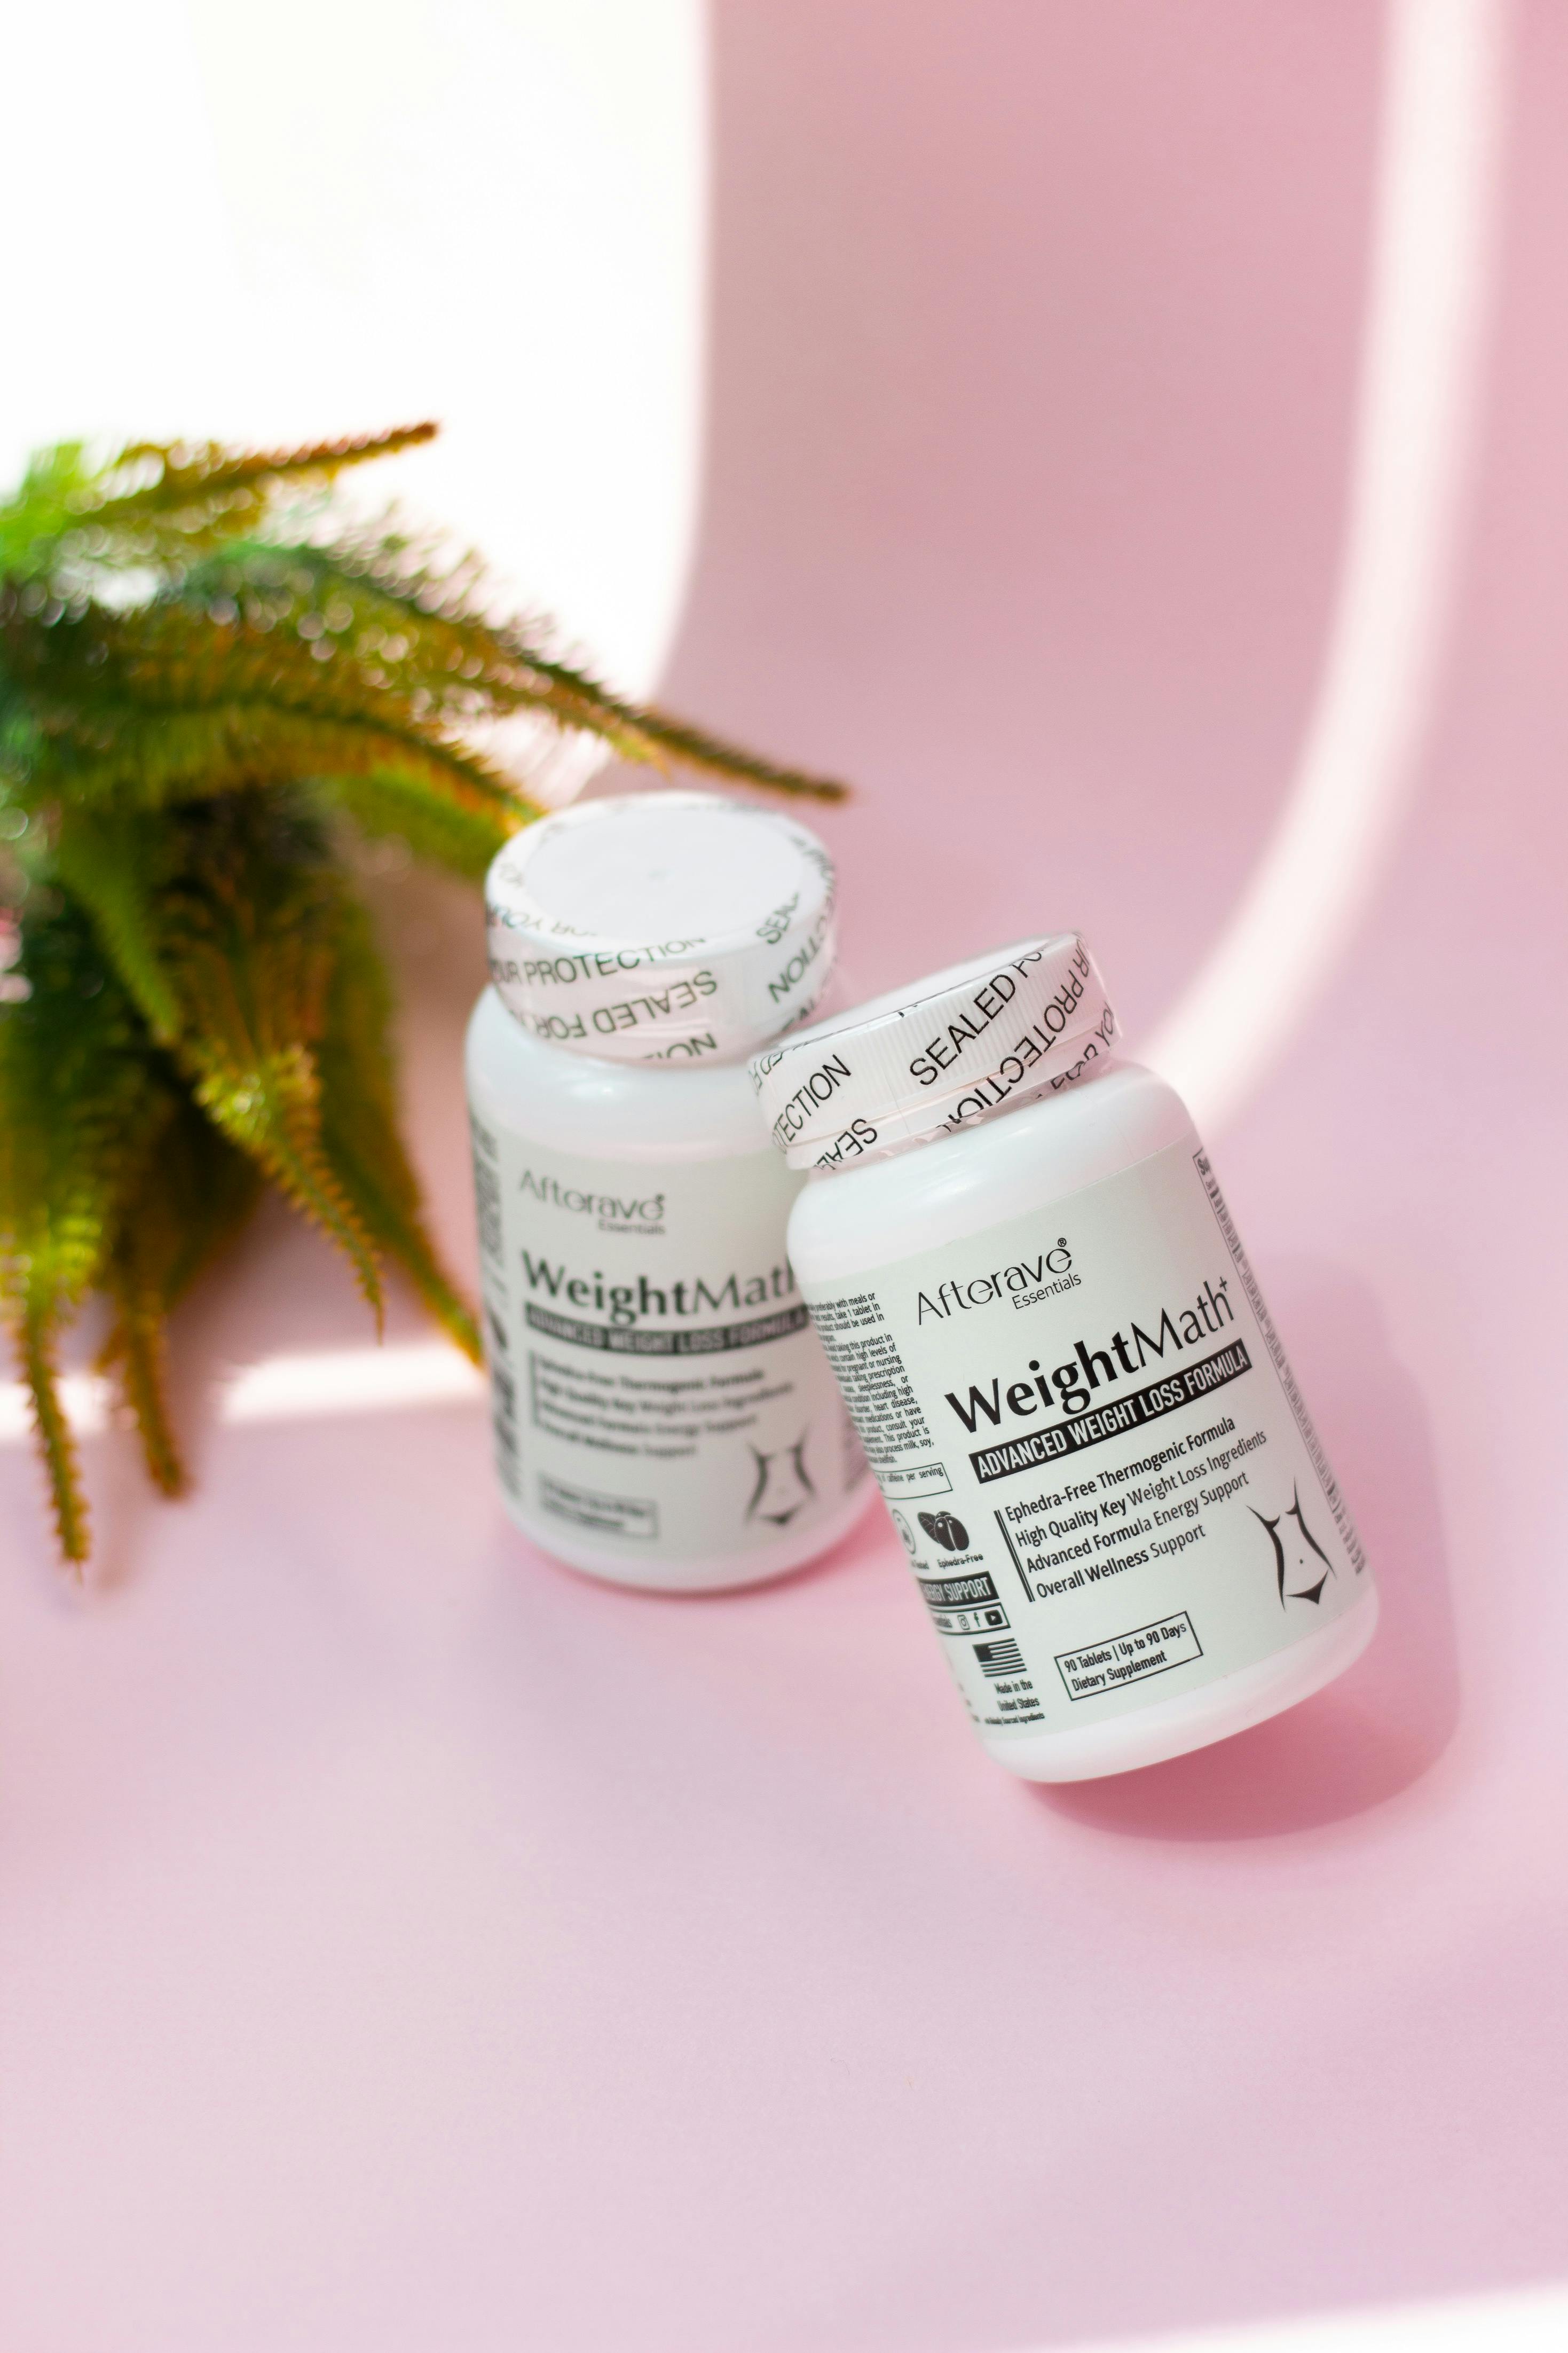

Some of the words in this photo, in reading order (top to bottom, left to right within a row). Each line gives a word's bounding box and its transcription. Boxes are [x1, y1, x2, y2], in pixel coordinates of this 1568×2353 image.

[593, 971, 718, 1034] SEALED
[909, 974, 1016, 1086] SEALED
[1012, 1272, 1082, 1310] Essentials
[836, 1297, 848, 1308] with
[848, 1294, 868, 1306] meals
[836, 1309, 847, 1319] take
[853, 1305, 872, 1316] tablet
[873, 1303, 880, 1311] in
[834, 1320, 851, 1331] should
[852, 1319, 859, 1327] be
[861, 1314, 876, 1325] used
[877, 1313, 884, 1321] in
[850, 1341, 860, 1350] this
[861, 1336, 885, 1350] product
[884, 1334, 893, 1342] in
[856, 1349, 869, 1361] high
[869, 1346, 887, 1357] levels
[889, 1343, 896, 1352] of
[847, 1363, 869, 1374] pregnant
[876, 1354, 902, 1367] nursing
[868, 1366, 905, 1380] prescription
[901, 1375, 908, 1384] or
[871, 1389, 898, 1401] including
[897, 1385, 913, 1396] high
[873, 1402, 888, 1411] heart
[891, 1397, 917, 1408] disease,
[904, 1407, 921, 1416] have
[976, 1430, 1067, 1479] ADVANCED
[1067, 1399, 1138, 1446] WEIGHT
[1142, 1378, 1185, 1417] LOSS
[1186, 1348, 1248, 1397] FORMULA
[886, 1420, 907, 1431] consult
[909, 1417, 925, 1429] your
[883, 1433, 895, 1442] This
[897, 1429, 921, 1442] product
[923, 1426, 929, 1434] is
[884, 1445, 903, 1455] process
[904, 1440, 919, 1450] milk,
[920, 1438, 934, 1447] soy,
[907, 1472, 916, 1483] per
[919, 1467, 943, 1478] serving
[1004, 1482, 1097, 1522] Ephedra-Free
[1097, 1441, 1187, 1489] Thermogenic
[1186, 1416, 1235, 1451] Formula
[1015, 1524, 1047, 1548] High
[1049, 1510, 1098, 1536] Quality
[1100, 1499, 1127, 1519] Key
[1127, 1477, 1178, 1506] Weight
[1177, 1463, 1207, 1486] Loss
[1207, 1430, 1267, 1473] Ingredients
[1027, 1538, 1094, 1574] Advanced
[1096, 1518, 1152, 1552] Formula
[1154, 1500, 1200, 1527] Energy
[1200, 1471, 1249, 1505] Support
[937, 1554, 983, 1569] Ephedra-Free
[1036, 1569, 1086, 1598] Overall
[1085, 1551, 1149, 1581] Wellness
[1150, 1524, 1207, 1559] Support
[944, 1577, 991, 1601] SUPPORT
[1063, 1659, 1077, 1673] 90
[1077, 1647, 1112, 1669] Tablets
[1118, 1640, 1133, 1657] Up
[1134, 1636, 1145, 1650] to
[1146, 1629, 1160, 1646] 90
[1161, 1622, 1187, 1642] Days
[1071, 1673, 1106, 1692] Dietary
[1106, 1651, 1167, 1681] Supplement
[994, 1682, 1013, 1694] Made
[1012, 1681, 1021, 1692] in
[1020, 1679, 1033, 1690] the
[997, 1699, 1018, 1711] United
[1017, 1697, 1039, 1709] States
